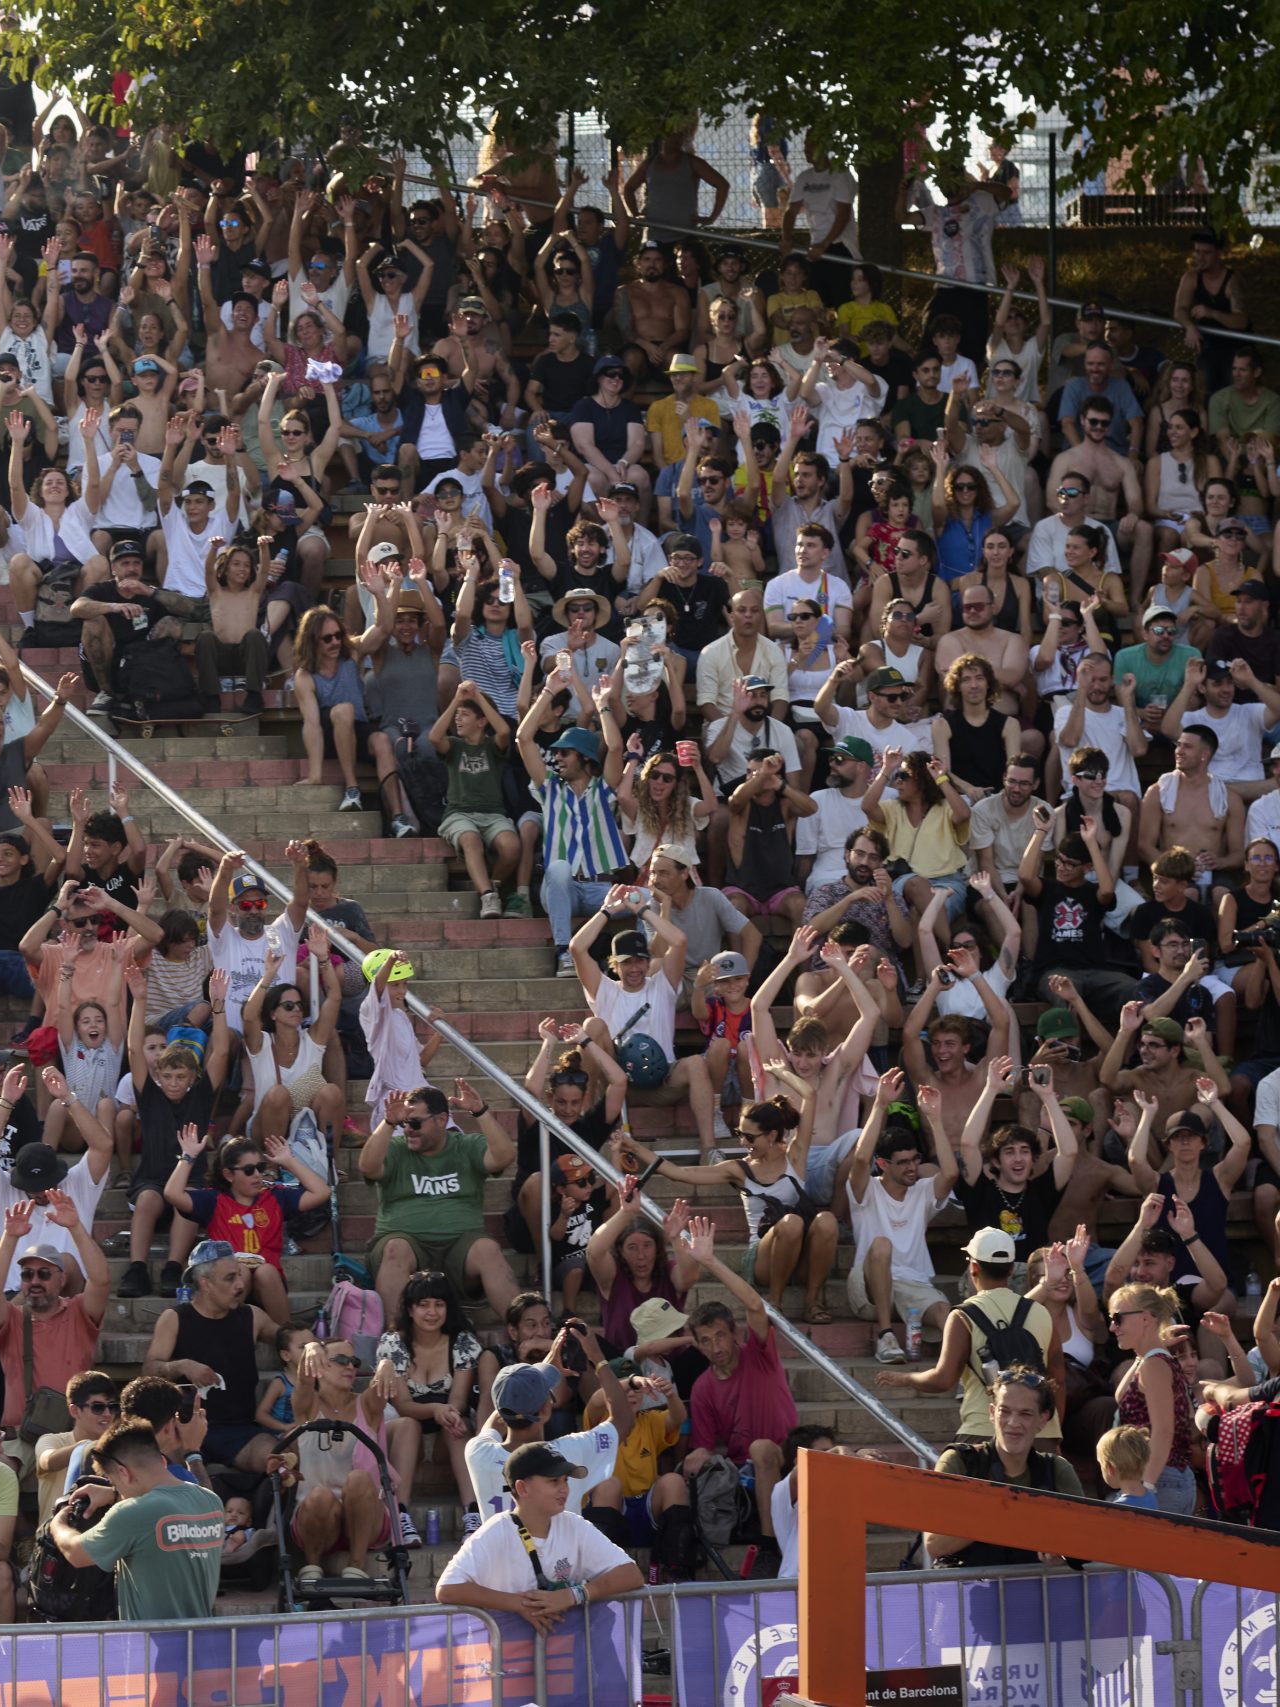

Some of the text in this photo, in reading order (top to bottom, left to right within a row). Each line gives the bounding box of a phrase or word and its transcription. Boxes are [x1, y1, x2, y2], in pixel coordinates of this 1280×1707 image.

[21, 217, 47, 231] VANS
[411, 1173, 461, 1196] VANS
[243, 1229, 261, 1253] 10
[167, 1523, 221, 1543] Billabong
[882, 1688, 897, 1699] de
[899, 1684, 958, 1699] Barcelona
